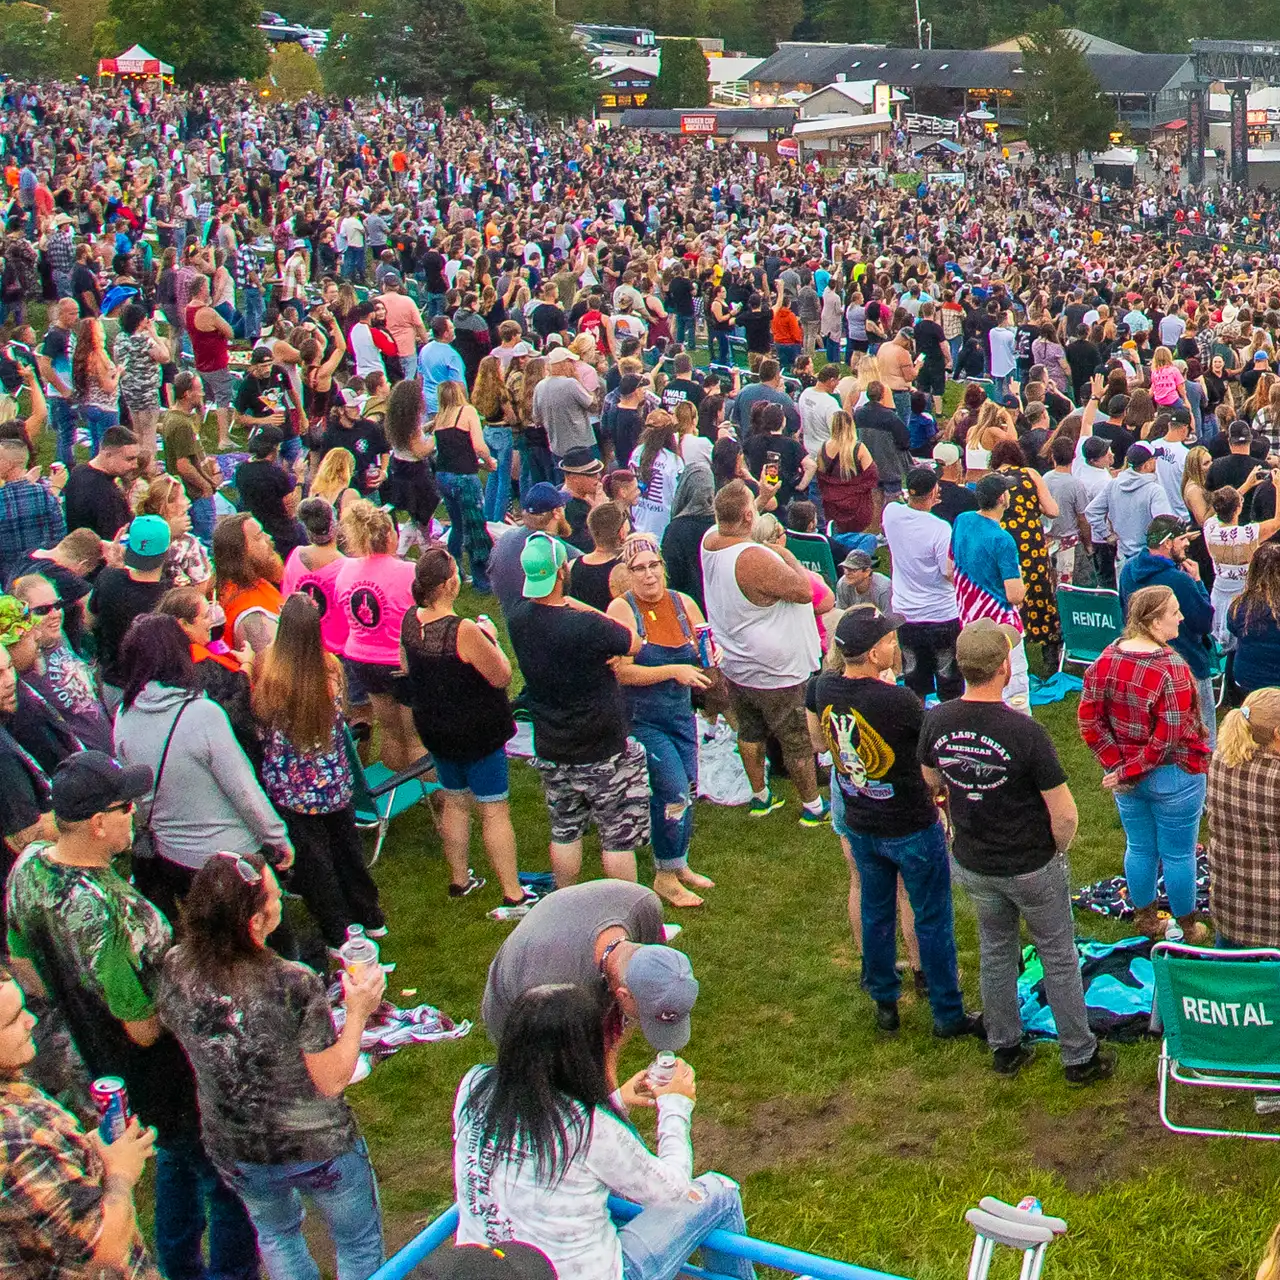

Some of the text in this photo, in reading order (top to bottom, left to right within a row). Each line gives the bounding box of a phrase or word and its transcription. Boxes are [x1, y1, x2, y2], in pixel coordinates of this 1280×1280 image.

[667, 389, 686, 398] WAS
[802, 561, 821, 573] TAL
[1072, 611, 1116, 629] RENTAL
[934, 731, 1012, 761] THE LAST GREAT
[945, 744, 992, 755] AMERICAN
[1182, 996, 1273, 1027] RENTAL
